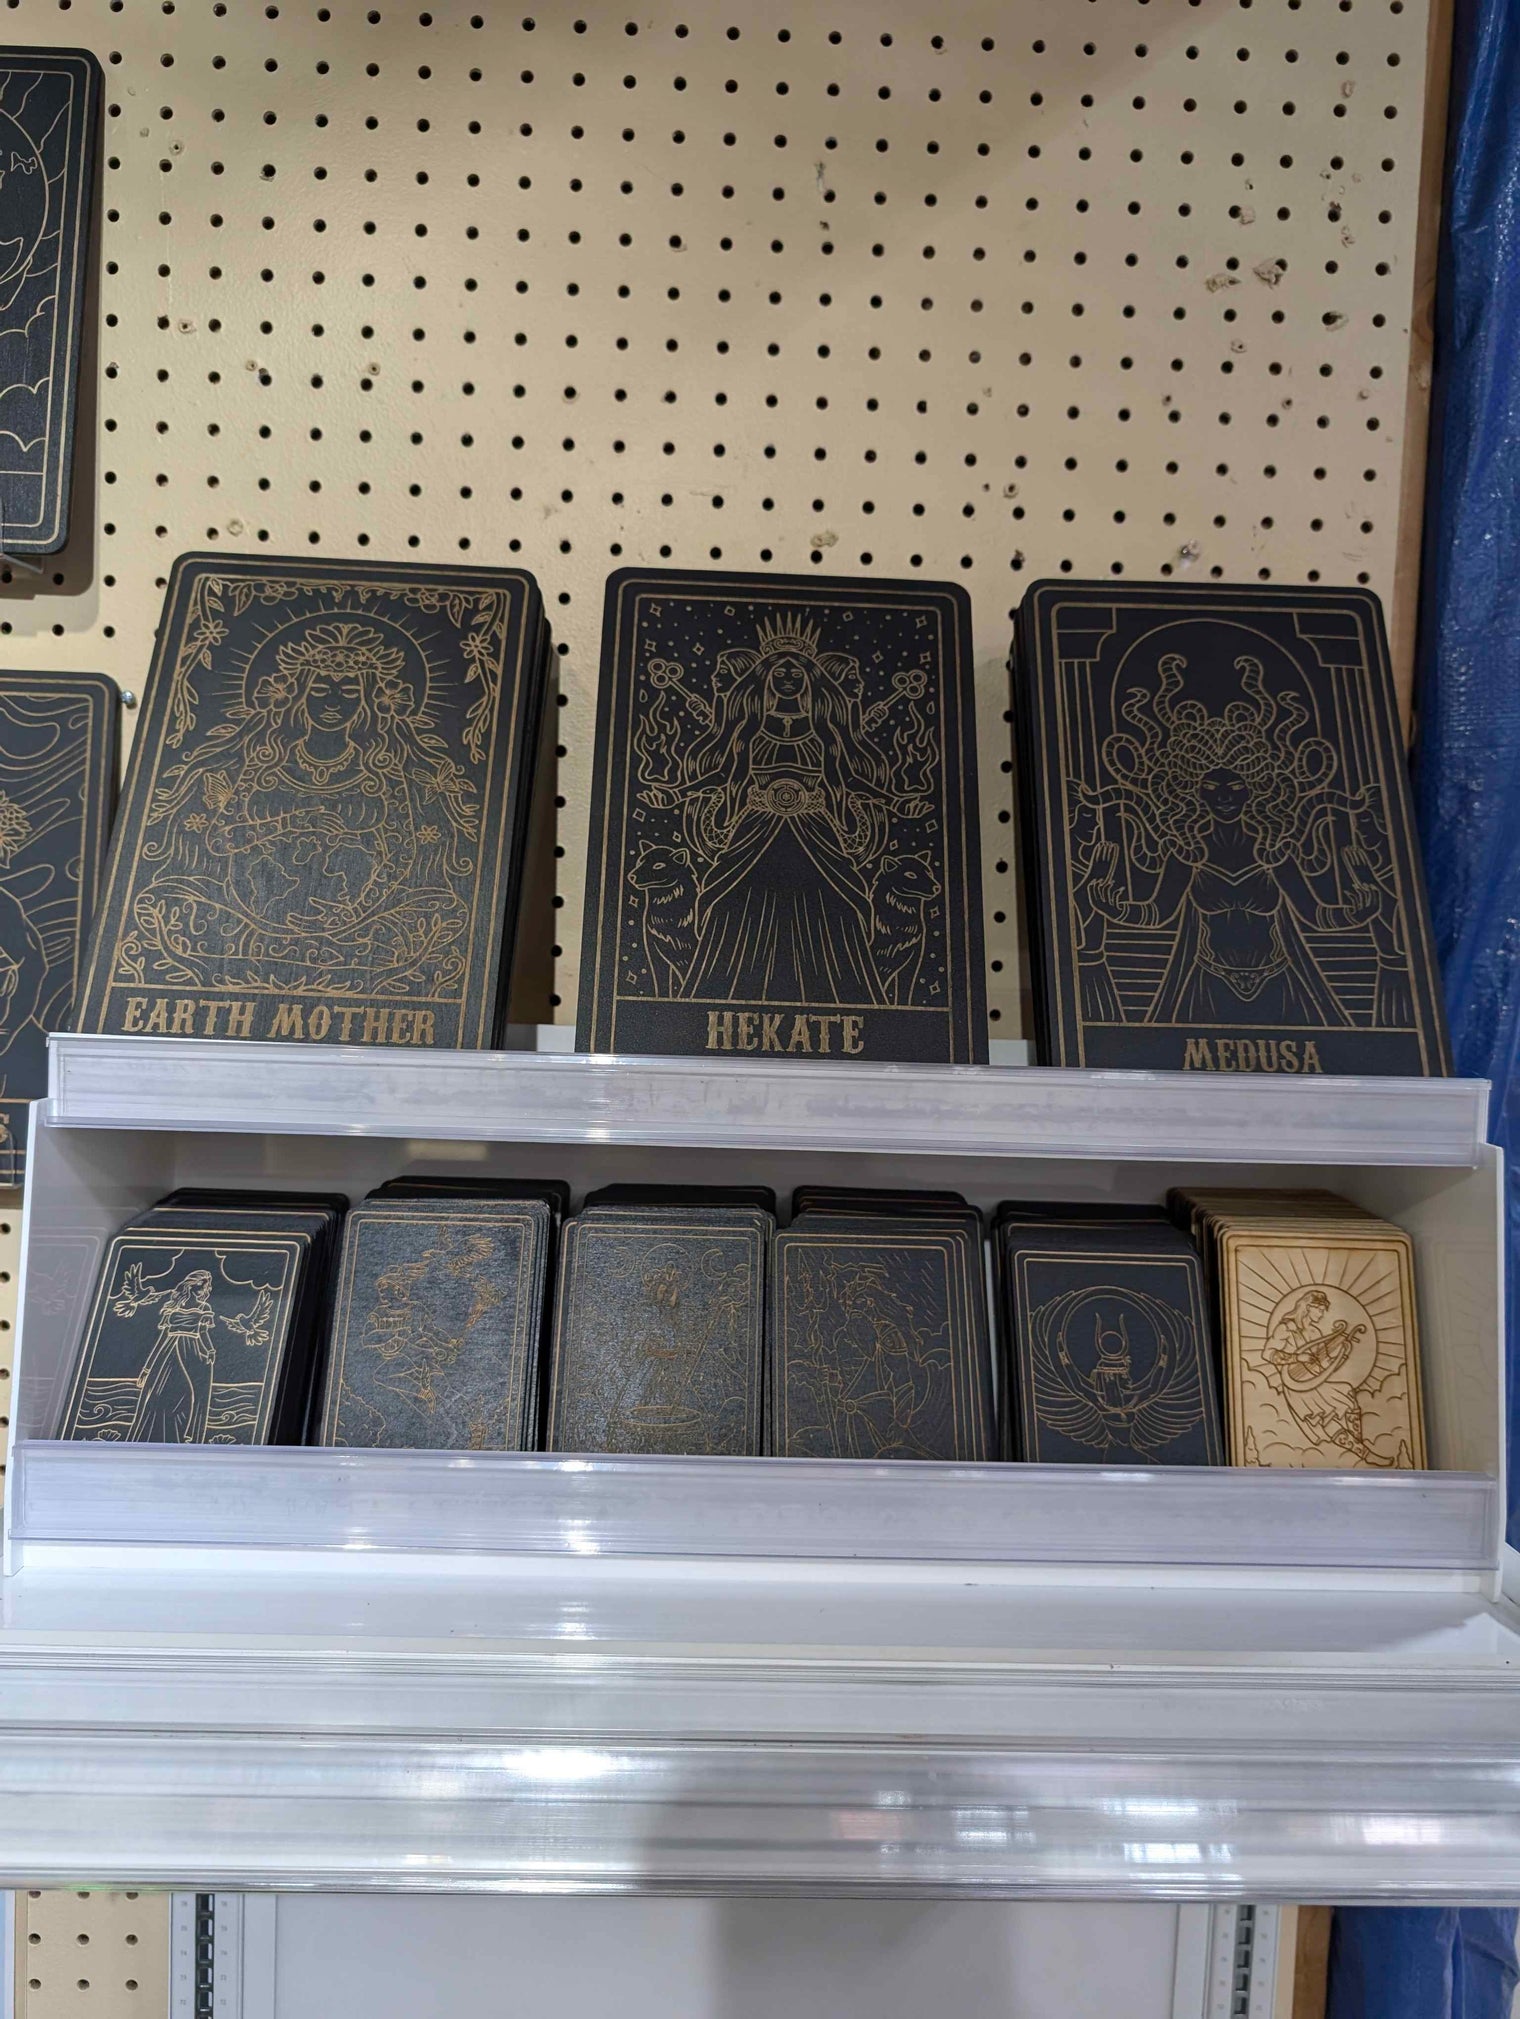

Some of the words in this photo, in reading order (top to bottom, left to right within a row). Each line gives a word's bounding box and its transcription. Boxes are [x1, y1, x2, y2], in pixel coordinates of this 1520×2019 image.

[121, 997, 256, 1037] EARTH
[266, 1003, 436, 1045] MOTHER
[705, 1010, 864, 1054] HEKATE
[1182, 1038, 1323, 1073] MEDUSA
